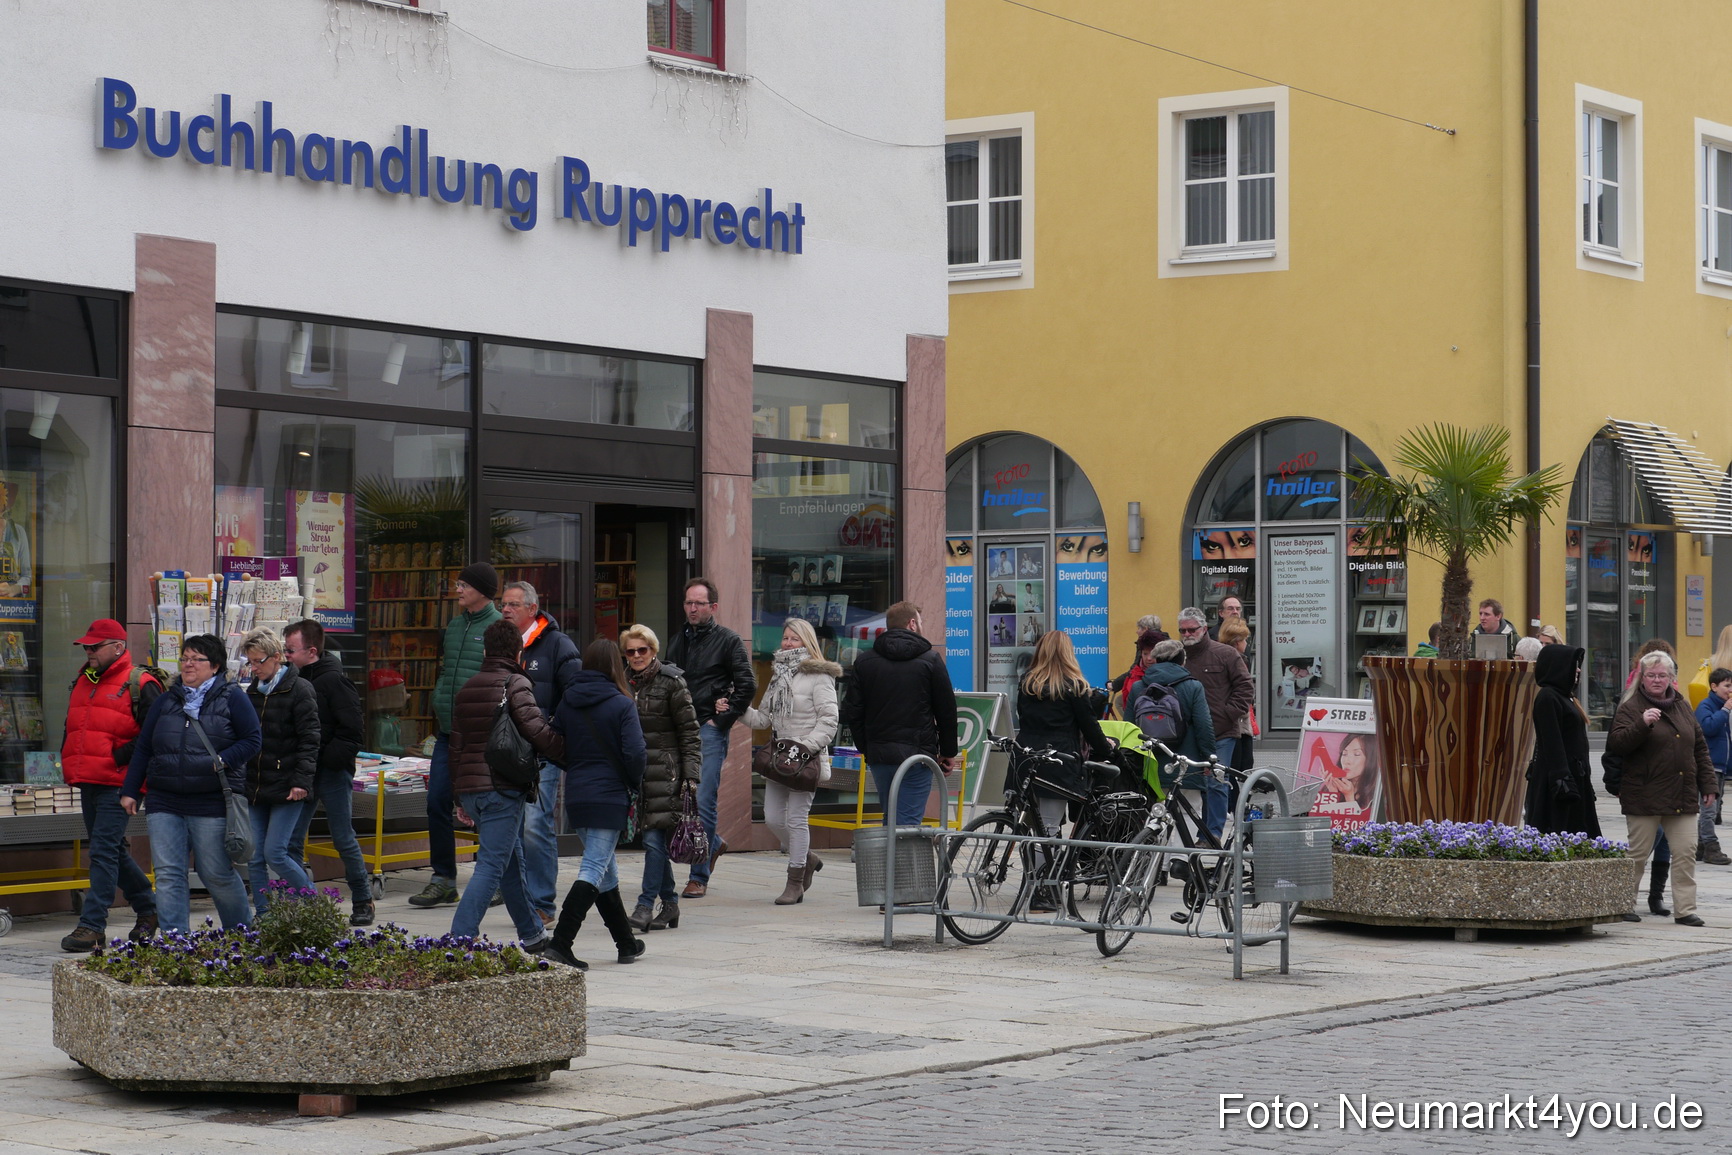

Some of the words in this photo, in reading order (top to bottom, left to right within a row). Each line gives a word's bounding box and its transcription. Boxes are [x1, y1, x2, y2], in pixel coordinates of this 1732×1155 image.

[95, 76, 539, 232] Buchhandlung
[555, 155, 806, 255] Rupprecht
[1278, 451, 1317, 480] FOTO
[994, 464, 1030, 489] FOTO
[1266, 477, 1336, 496] hailer
[982, 489, 1046, 507] hailer
[780, 500, 865, 517] Empfehlungen
[306, 521, 336, 534] Weniger
[376, 519, 418, 531] Romane
[310, 532, 331, 543] Stress
[1293, 538, 1324, 548] Babypass
[302, 544, 320, 554] mehr
[320, 544, 339, 556] Leben
[1201, 565, 1227, 576] Digitale
[1228, 564, 1249, 573] Bilder
[1348, 562, 1384, 572] Digitale
[1074, 585, 1100, 596] bilder
[320, 613, 354, 626] Rupprecht
[1331, 709, 1367, 721] STREB
